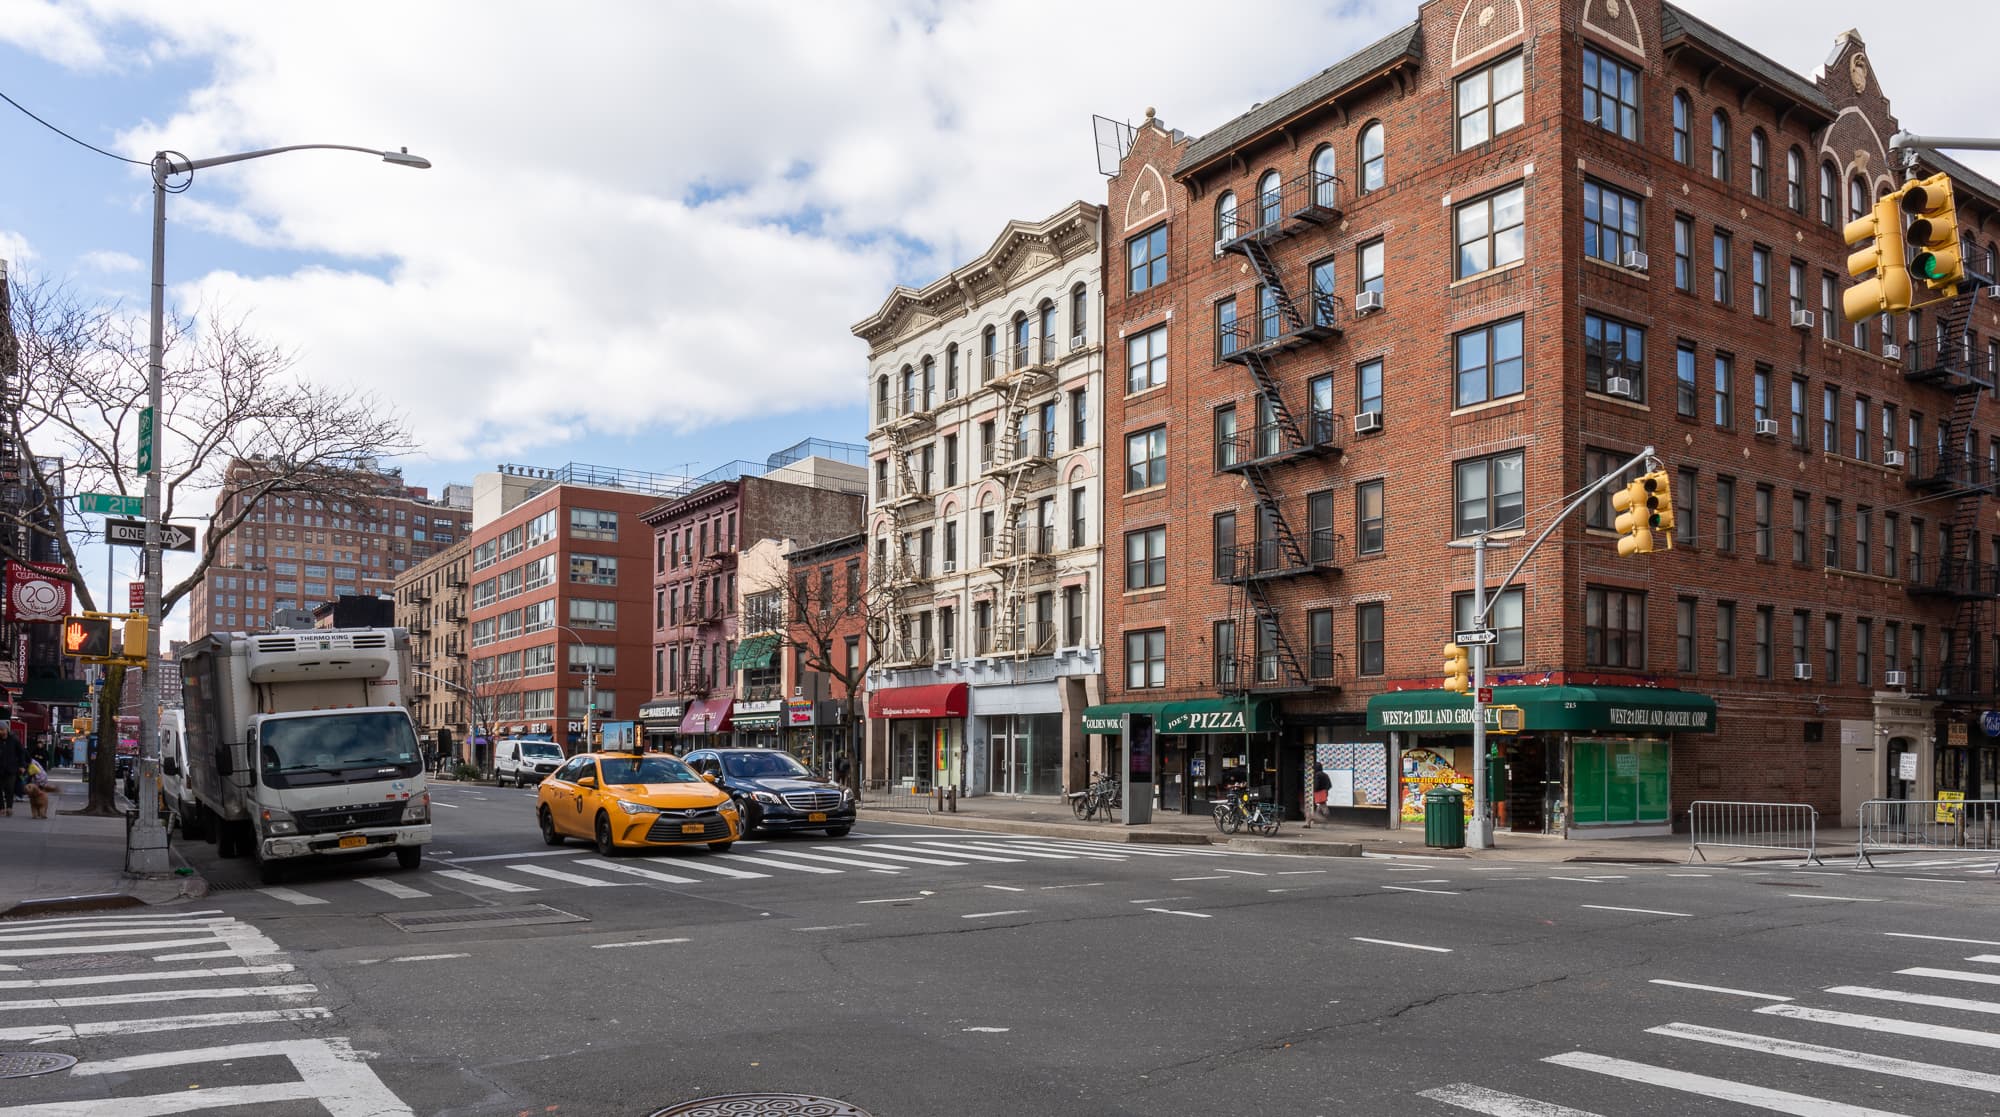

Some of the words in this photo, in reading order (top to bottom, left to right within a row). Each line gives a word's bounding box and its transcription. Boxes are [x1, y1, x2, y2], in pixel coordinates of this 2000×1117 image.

[83, 495, 98, 511] W
[119, 527, 145, 540] ONE
[25, 585, 56, 604] 20
[1460, 634, 1473, 642] ONE
[1478, 633, 1492, 641] WAY
[1086, 718, 1106, 729] GOLDEN
[1106, 718, 1118, 729] WOK
[1167, 713, 1189, 730] JOE'S
[1189, 711, 1246, 729] PIZZA
[1382, 710, 1404, 726] WEST
[1415, 709, 1433, 725] DELI
[1436, 709, 1453, 724] AND
[1455, 708, 1493, 724] GROCY
[1610, 708, 1627, 725] WEST
[1634, 709, 1649, 725] DELI
[1650, 710, 1663, 726] AND
[1664, 711, 1691, 727] GROCERY
[1692, 712, 1708, 727] CORP
